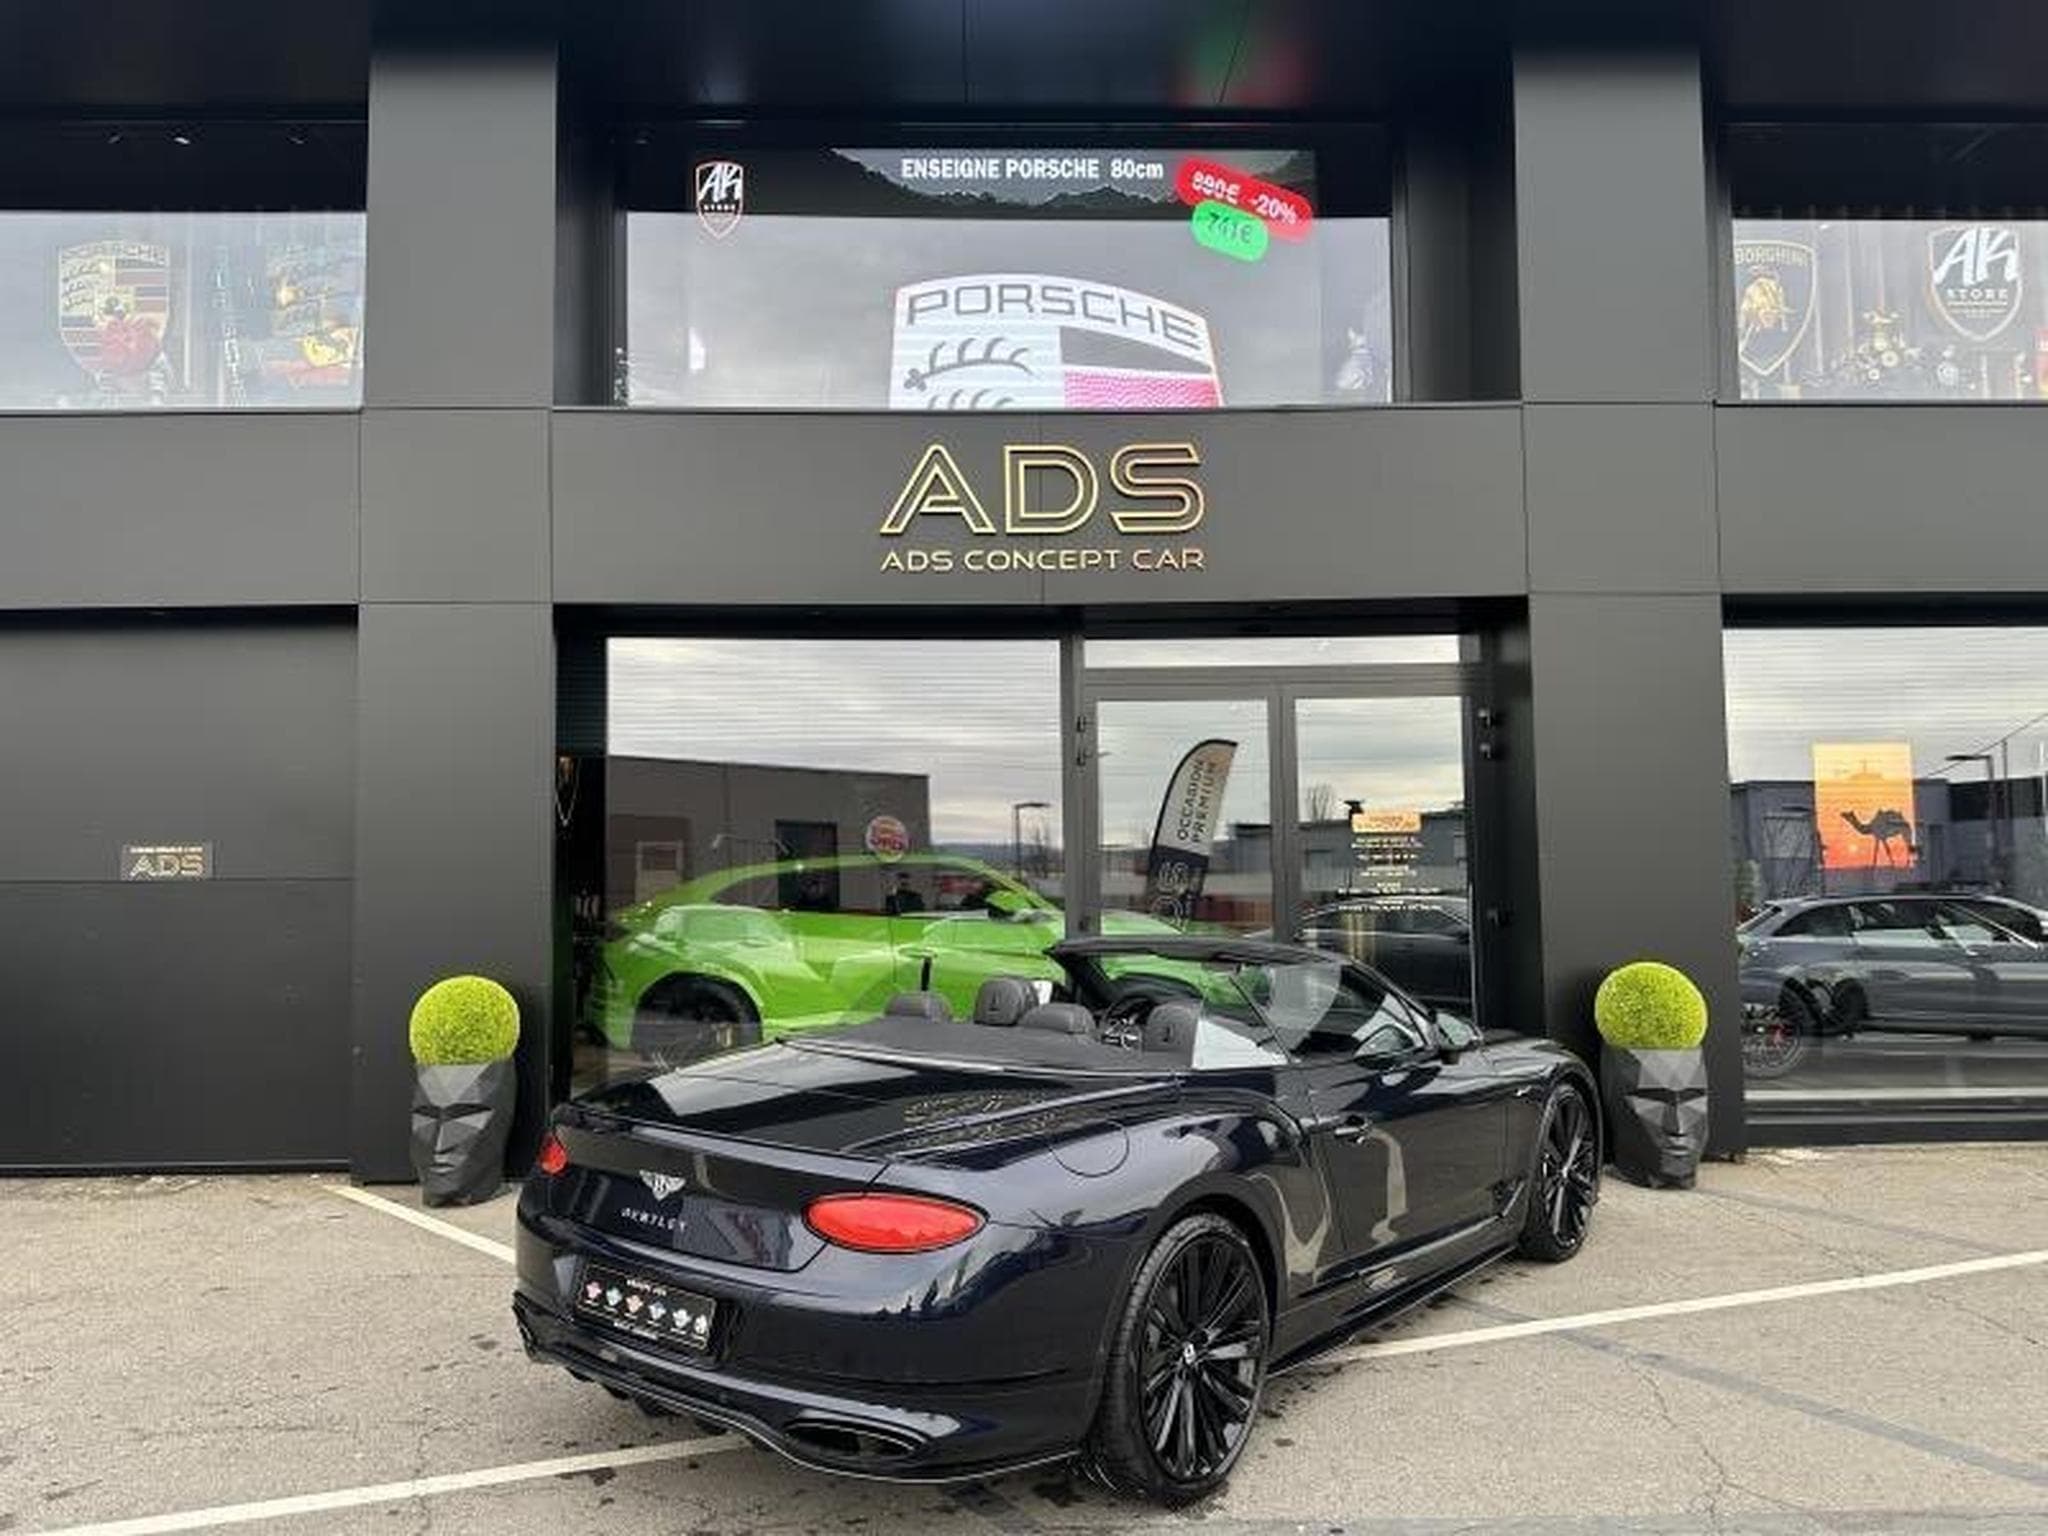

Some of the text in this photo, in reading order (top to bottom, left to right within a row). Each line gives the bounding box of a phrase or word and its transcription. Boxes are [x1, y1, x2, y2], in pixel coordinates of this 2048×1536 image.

[901, 158, 1164, 179] ENSEIGNE PORSCHE 80cm
[907, 283, 1202, 351] PORSCHE
[879, 443, 1205, 535] ADS
[880, 550, 1205, 572] ADS CONCEPT CAR
[1177, 759, 1204, 841] OCCASION
[1192, 761, 1216, 843] PREMIUM
[129, 854, 203, 877] ADS
